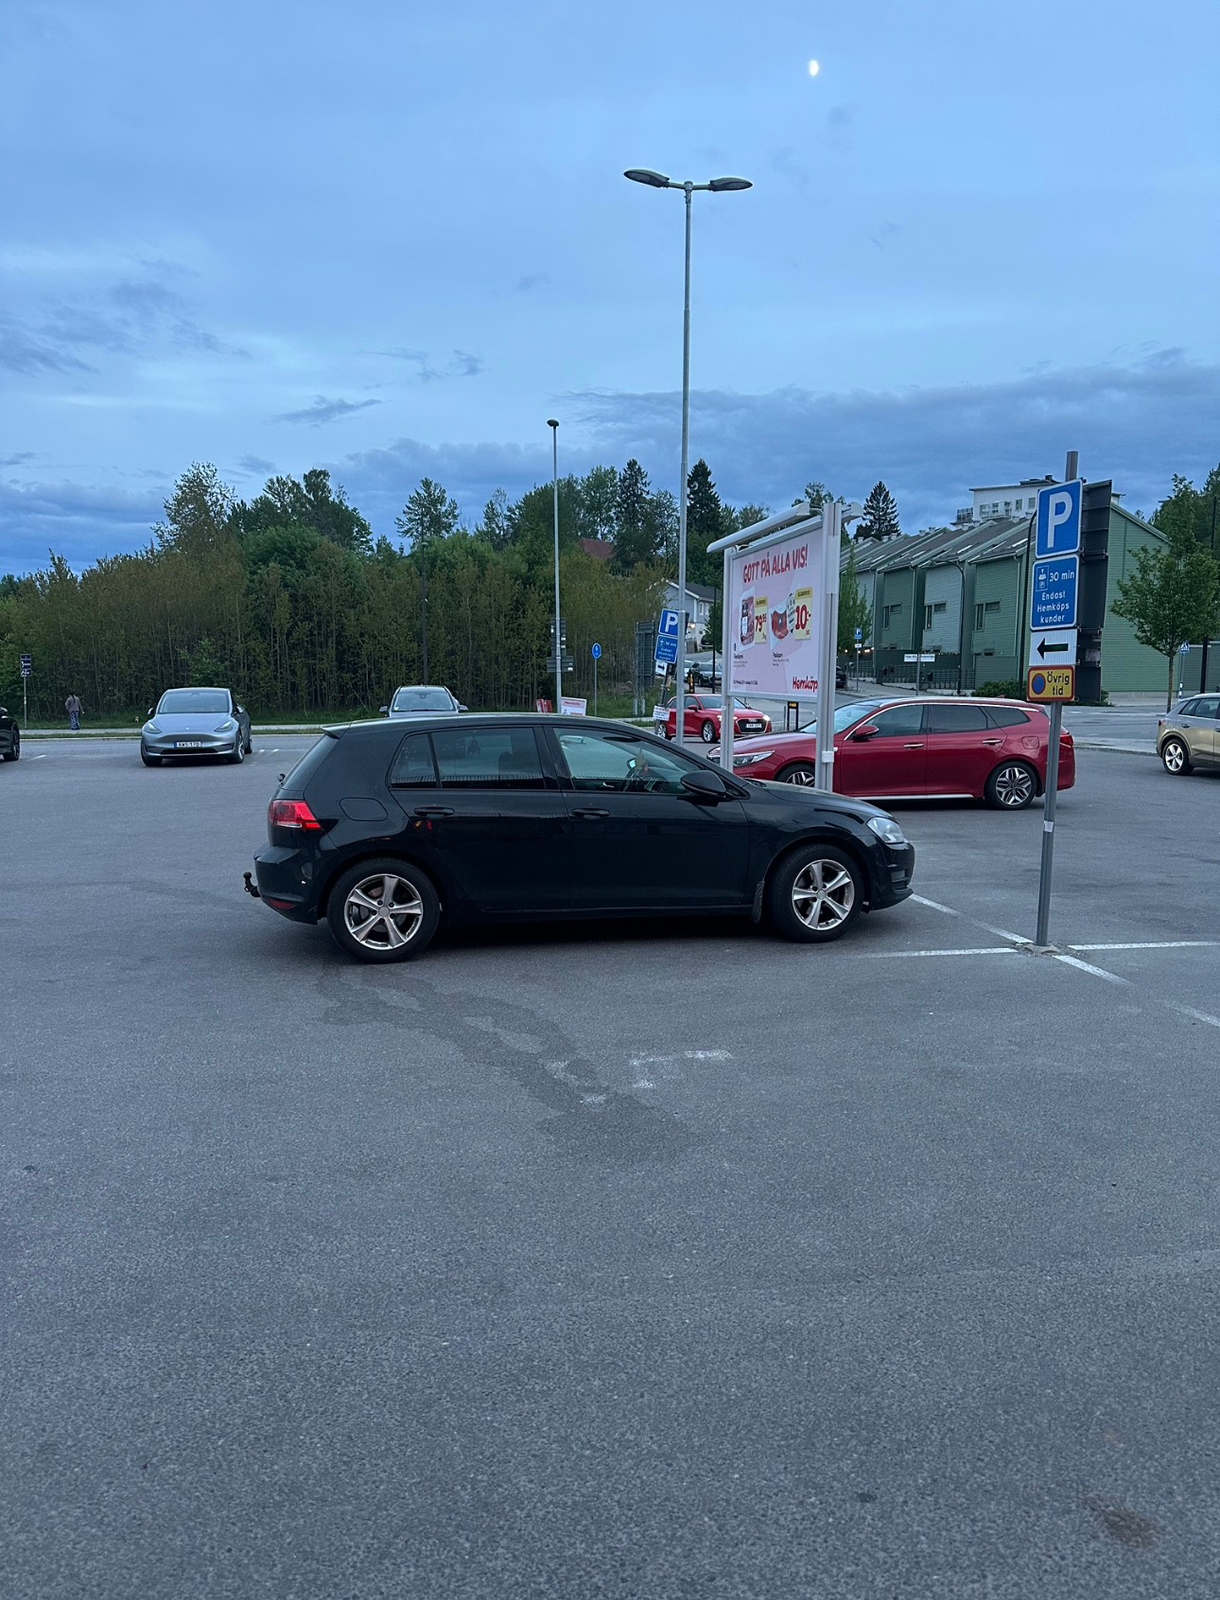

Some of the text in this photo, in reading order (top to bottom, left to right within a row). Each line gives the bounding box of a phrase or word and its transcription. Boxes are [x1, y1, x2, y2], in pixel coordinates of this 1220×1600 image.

[1047, 491, 1073, 549] P
[742, 543, 809, 583] GOTT PÅ ALLA VIS!
[1049, 569, 1075, 582] 30 min
[1041, 590, 1066, 601] Endast
[1037, 601, 1070, 614] Hemköps
[664, 611, 678, 633] P
[1040, 614, 1066, 624] kunder
[1046, 671, 1070, 685] Övrig
[1052, 686, 1064, 696] tid
